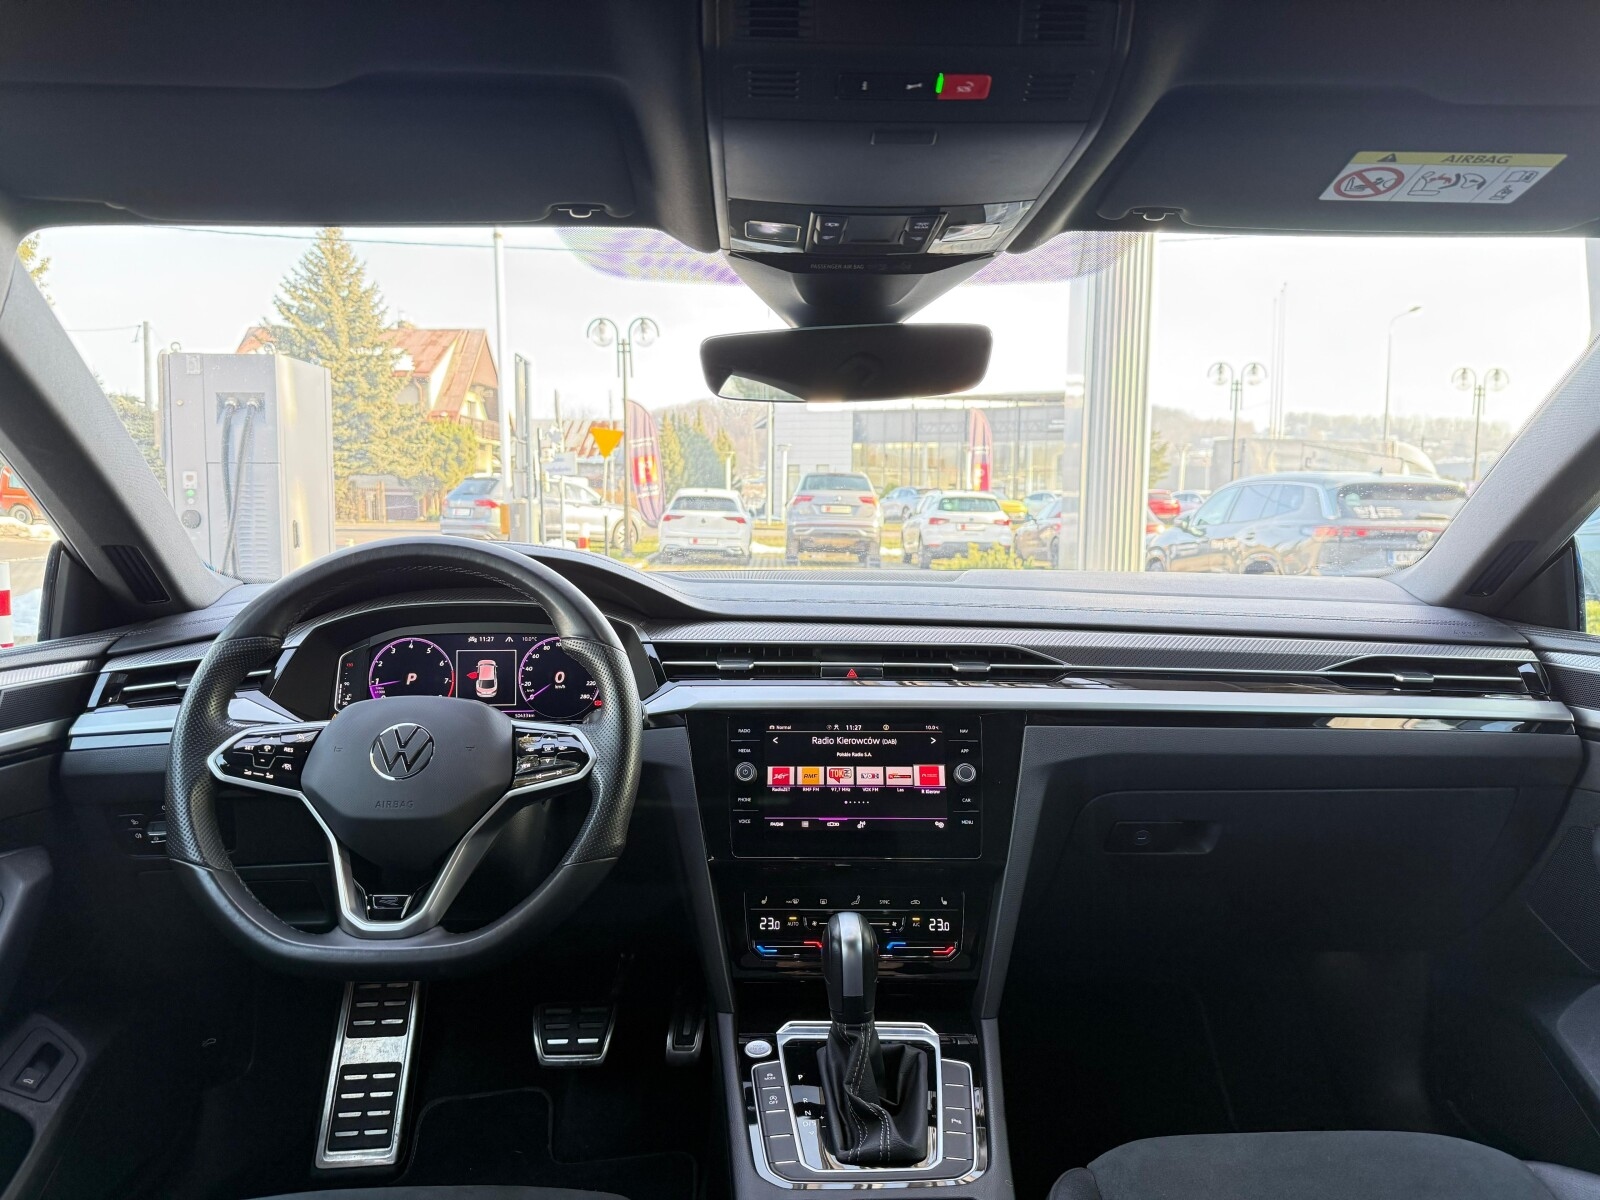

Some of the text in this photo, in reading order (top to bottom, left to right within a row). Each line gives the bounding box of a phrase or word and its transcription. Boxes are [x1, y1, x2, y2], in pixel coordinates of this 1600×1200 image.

[1440, 154, 1512, 164] AIRBAG
[406, 672, 418, 685] P
[554, 671, 565, 684] 0
[812, 736, 834, 745] Radio
[836, 736, 880, 745] Kierowców
[375, 800, 414, 808] AIRBAG
